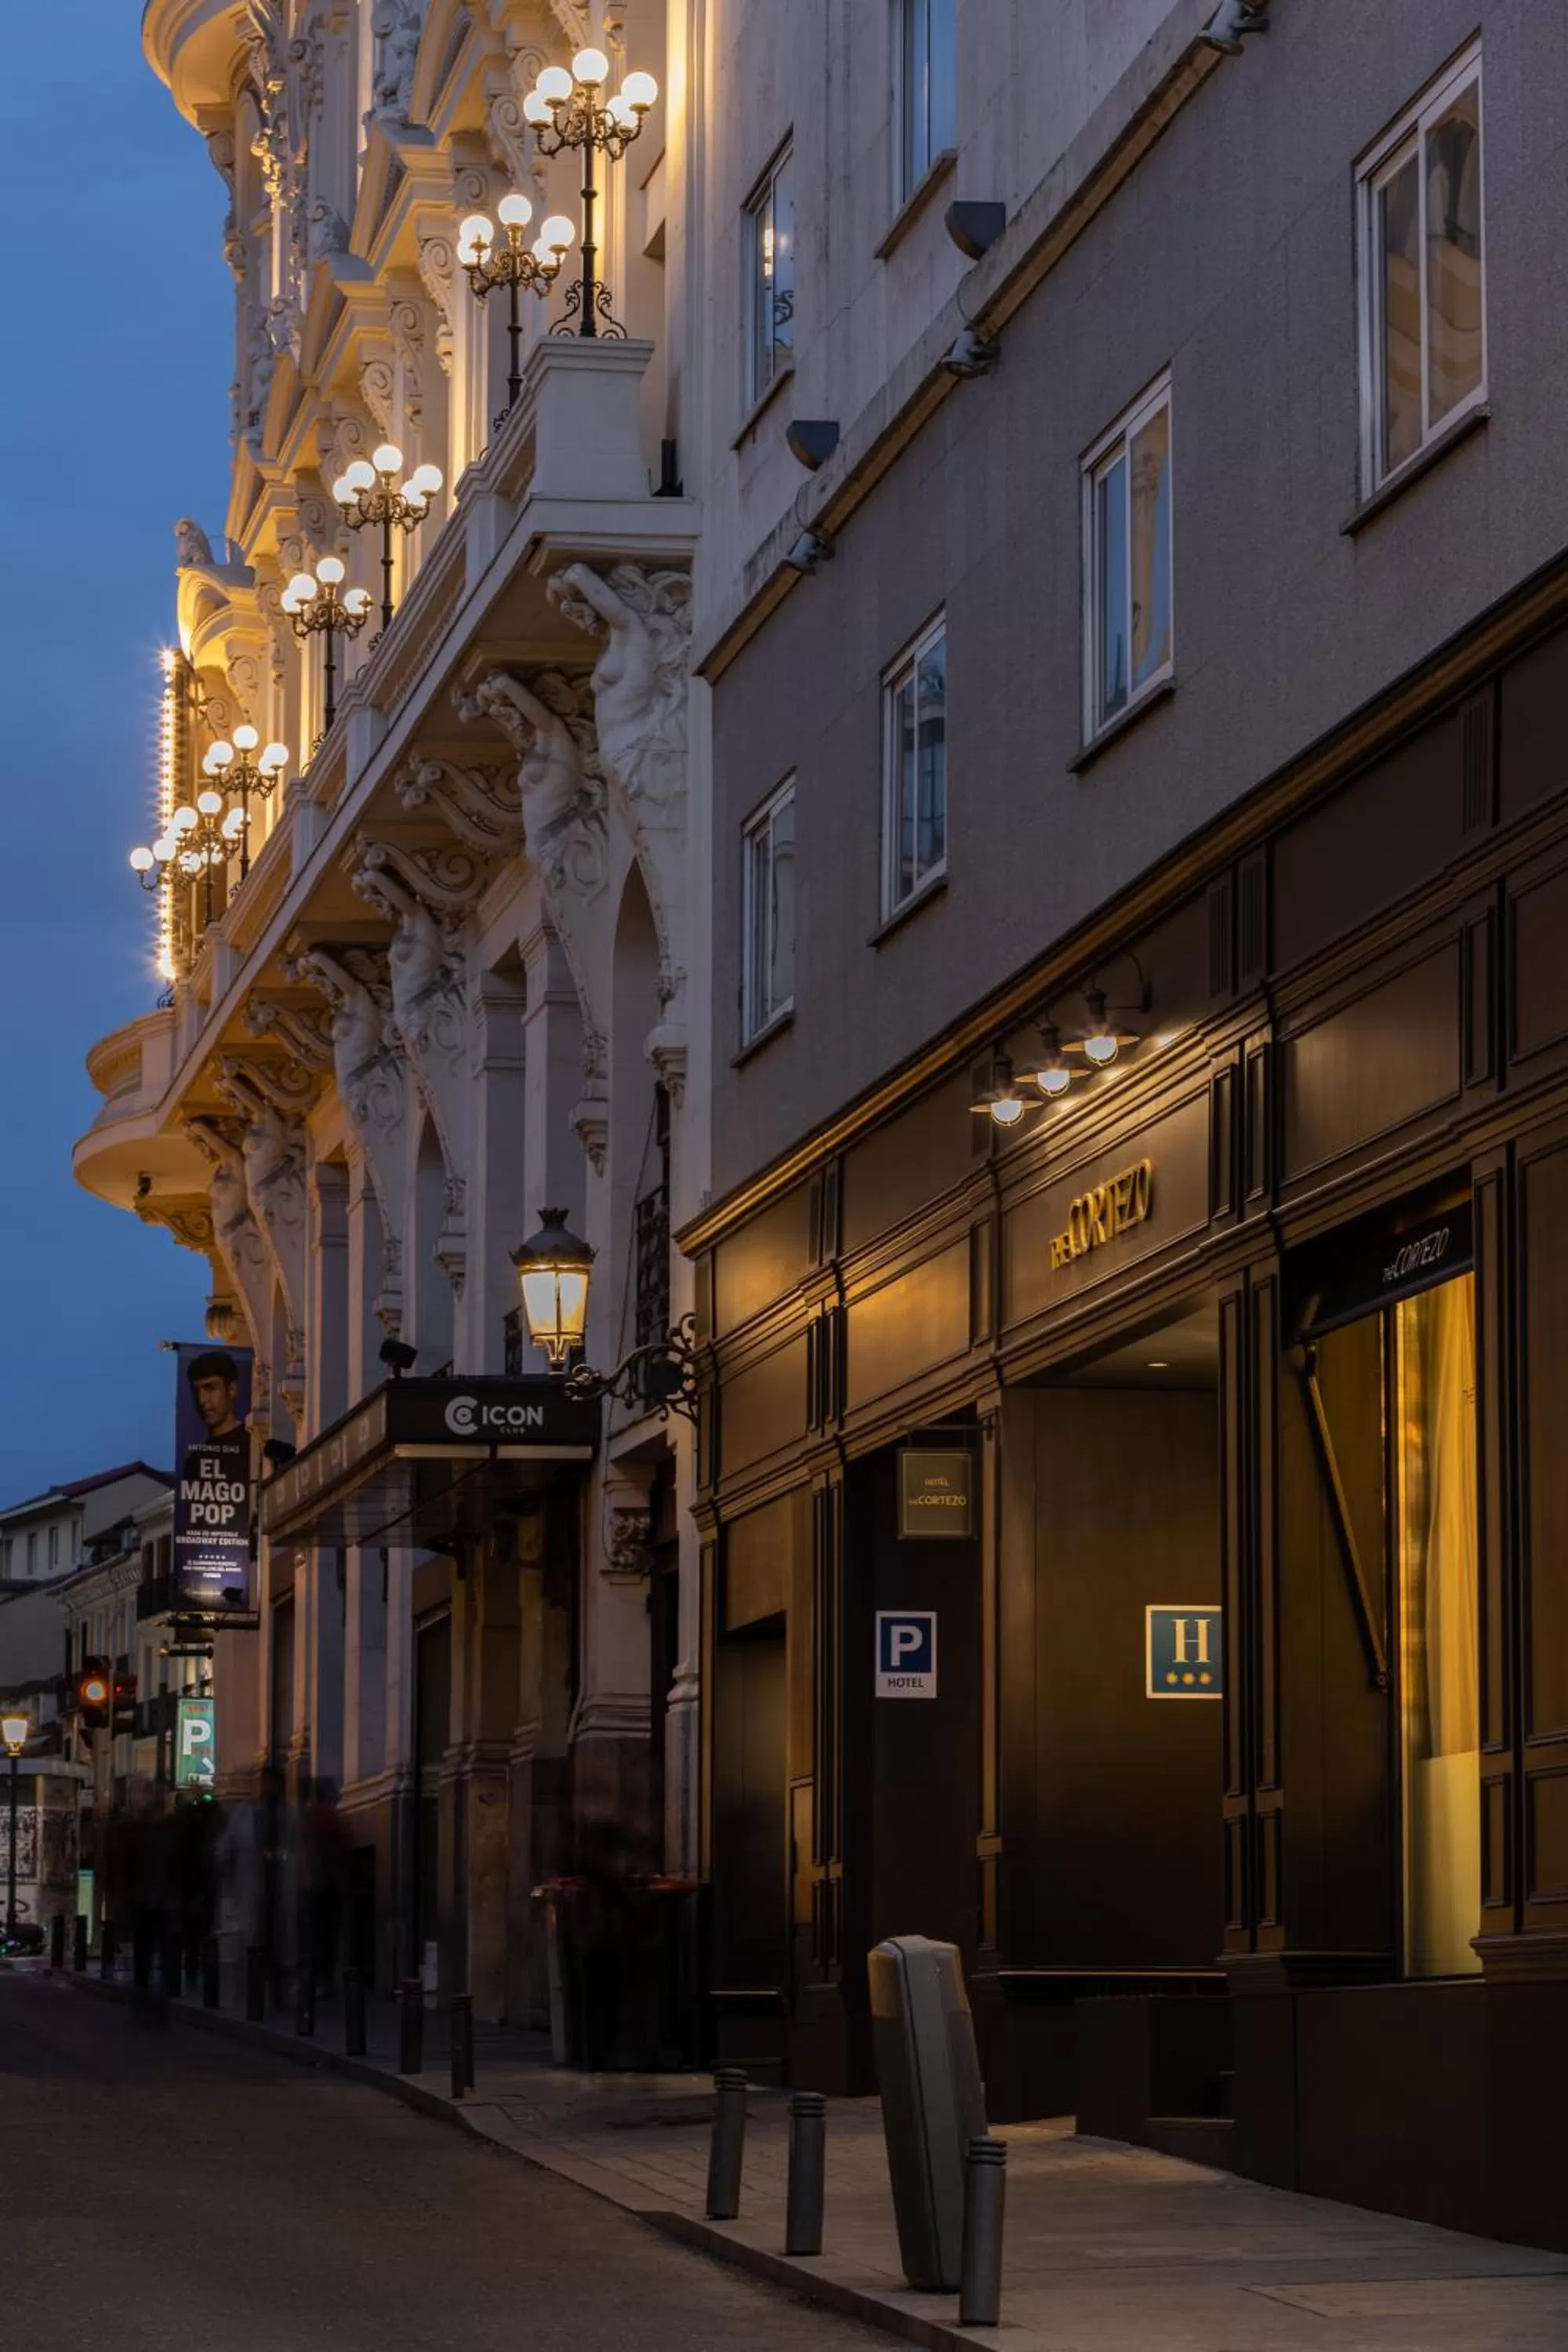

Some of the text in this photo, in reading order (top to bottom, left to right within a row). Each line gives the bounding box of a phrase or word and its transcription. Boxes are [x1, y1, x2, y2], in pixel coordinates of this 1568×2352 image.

[1069, 1158, 1152, 1258] CORTEZO
[1394, 1226, 1450, 1276] CORTEZO
[481, 1405, 543, 1426] ICON
[499, 1426, 527, 1435] CLUB
[199, 1457, 227, 1479] EL
[180, 1479, 245, 1503] MAGO
[918, 1494, 967, 1506] CORTEZO
[190, 1502, 236, 1525] POP
[890, 1624, 924, 1667] P
[1171, 1618, 1212, 1663] H
[887, 1677, 924, 1688] HOTEL
[182, 1719, 210, 1755] P
